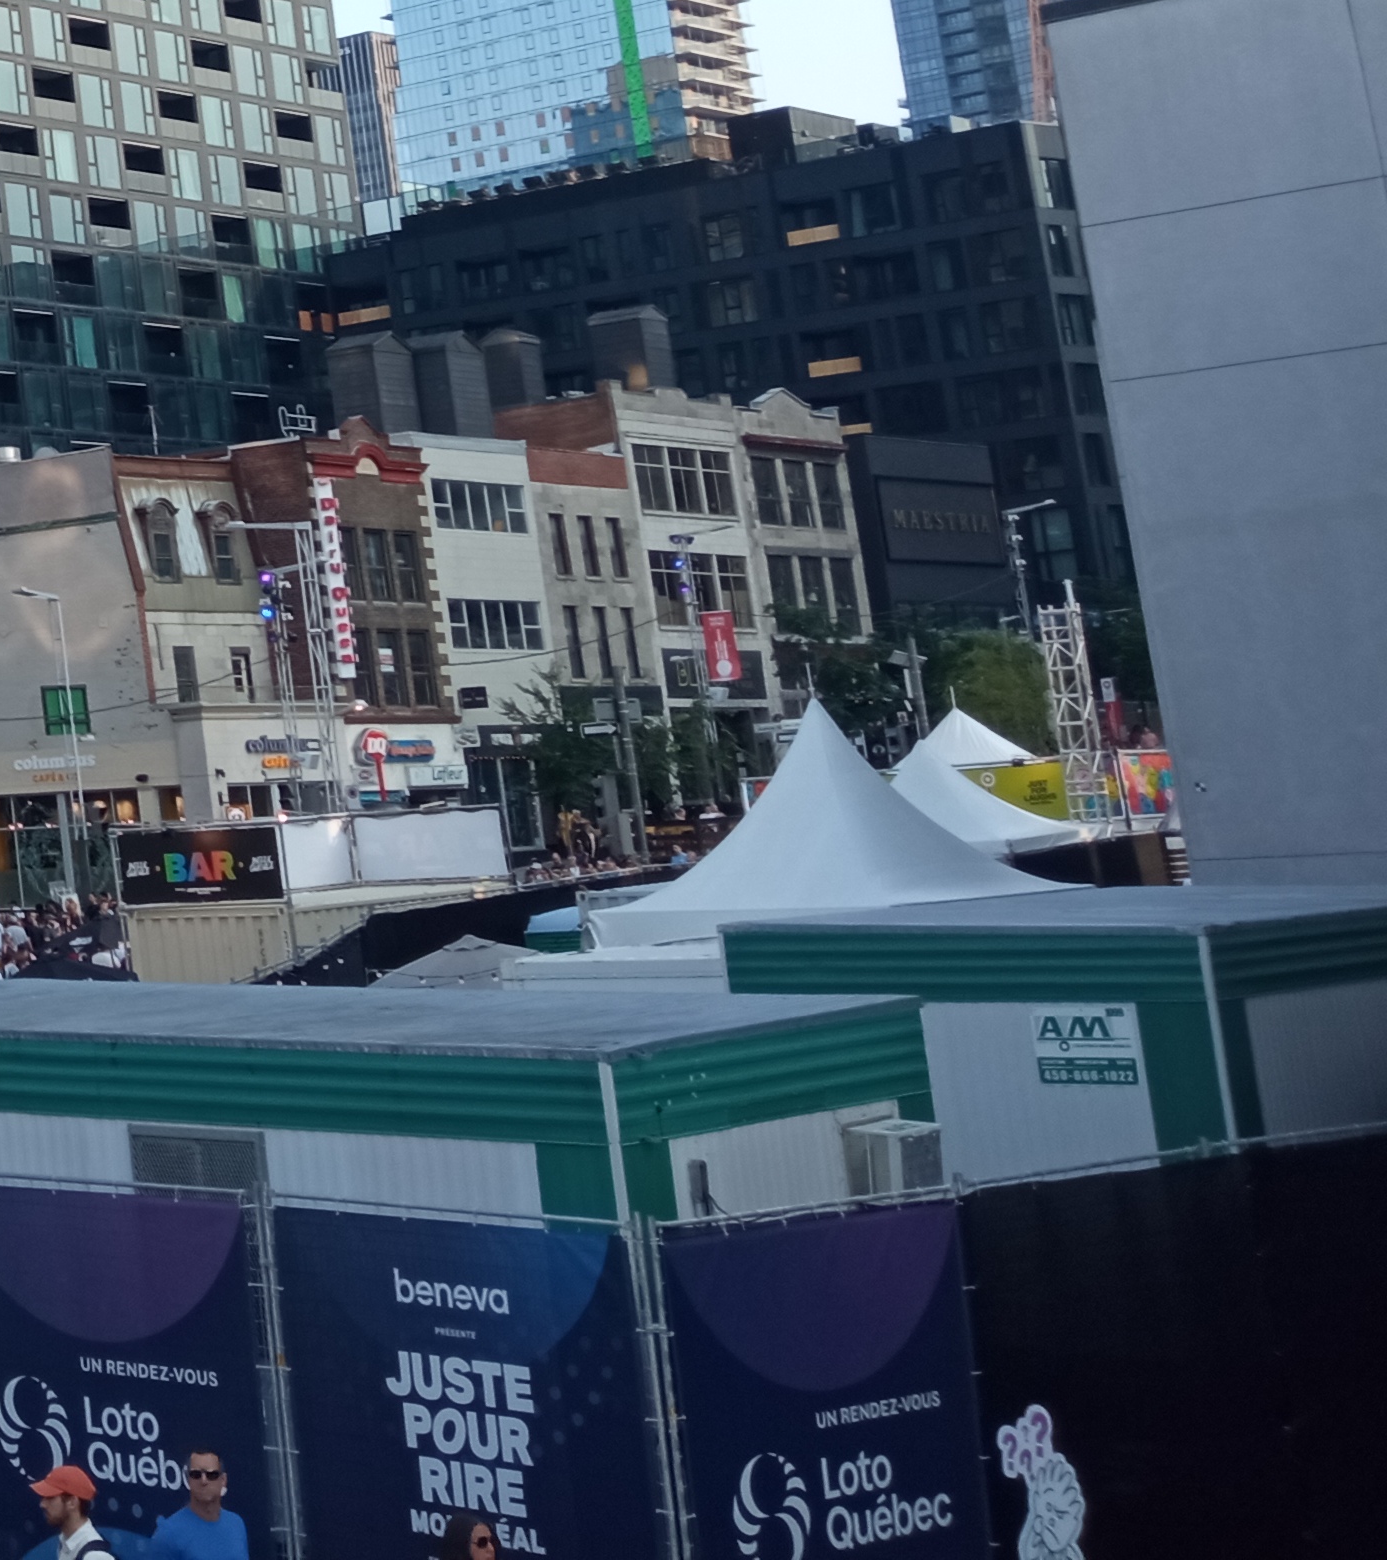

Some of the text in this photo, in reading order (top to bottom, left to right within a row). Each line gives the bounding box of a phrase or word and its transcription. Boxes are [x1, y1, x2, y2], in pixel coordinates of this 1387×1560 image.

[892, 509, 993, 533] MAESTRIA
[433, 767, 463, 782] Lafleur
[164, 851, 237, 882] BAR
[392, 1267, 510, 1314] beneva
[434, 1326, 476, 1340] PRÉSENTE
[79, 1356, 219, 1387] UN RENDEZ-VOUS
[385, 1350, 535, 1414] JUSTE
[83, 1396, 159, 1442] Loto
[815, 1391, 941, 1428] UN RENDEZ-VOUS
[403, 1402, 534, 1467] POUR
[418, 1455, 528, 1519] RIRE
[820, 1451, 892, 1500] Loto
[410, 1508, 547, 1556] MOÉAL
[826, 1493, 953, 1551] Québec
